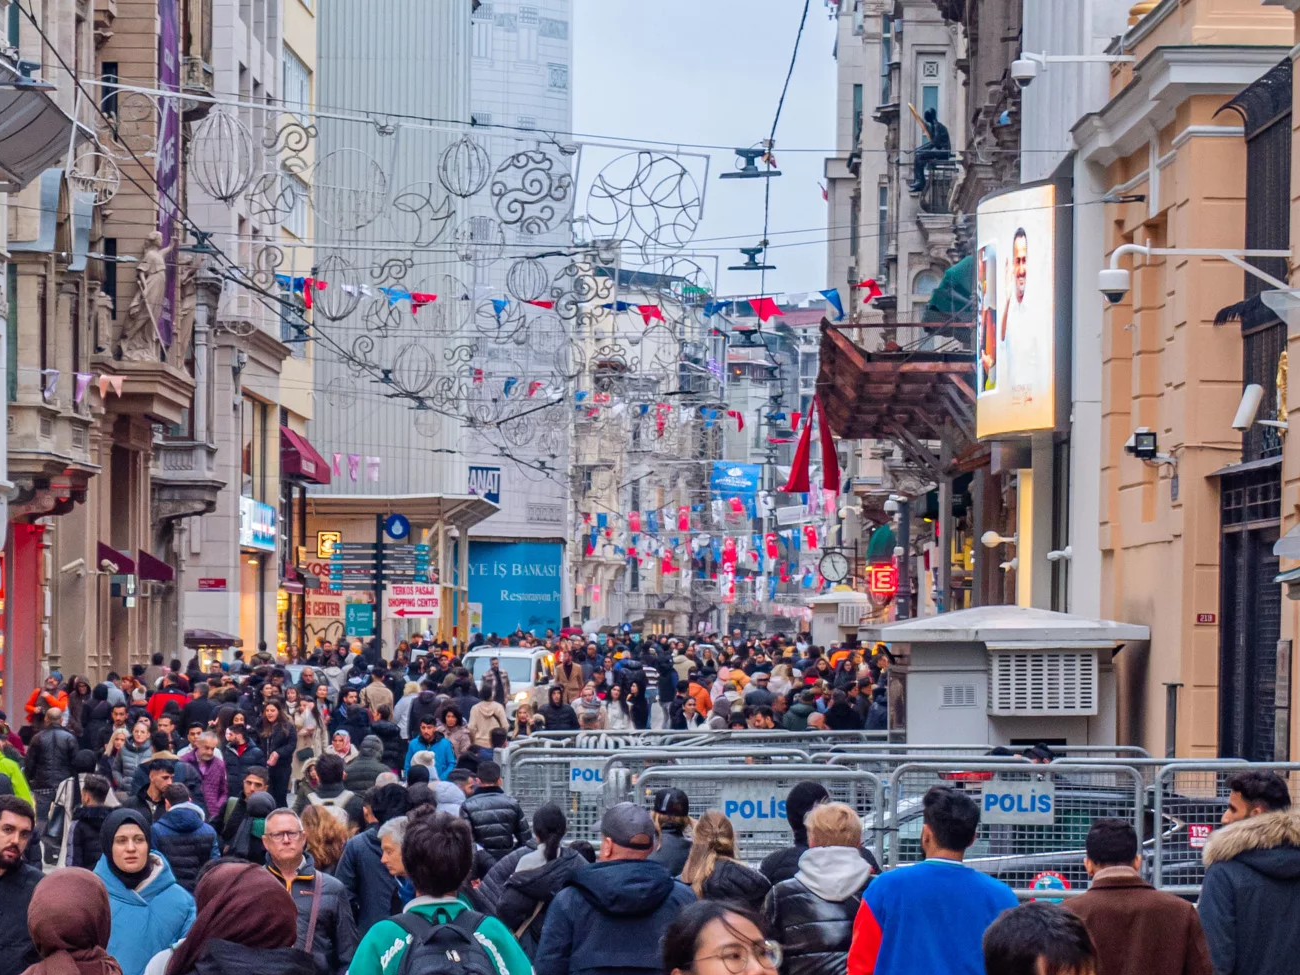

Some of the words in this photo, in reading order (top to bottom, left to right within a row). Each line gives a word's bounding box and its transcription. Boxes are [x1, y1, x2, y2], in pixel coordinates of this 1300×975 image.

[494, 561, 507, 578] İŞ
[512, 563, 556, 577] BANKASI
[392, 585, 414, 596] TERKOS
[500, 589, 551, 604] Restorasyon
[313, 601, 340, 616] CENTER
[387, 597, 415, 608] SHOPPING
[416, 597, 439, 608] CENTER
[571, 767, 604, 782] POL
[725, 796, 788, 819] POLİS
[985, 788, 1052, 813] POLİS
[1191, 825, 1208, 837] 112
